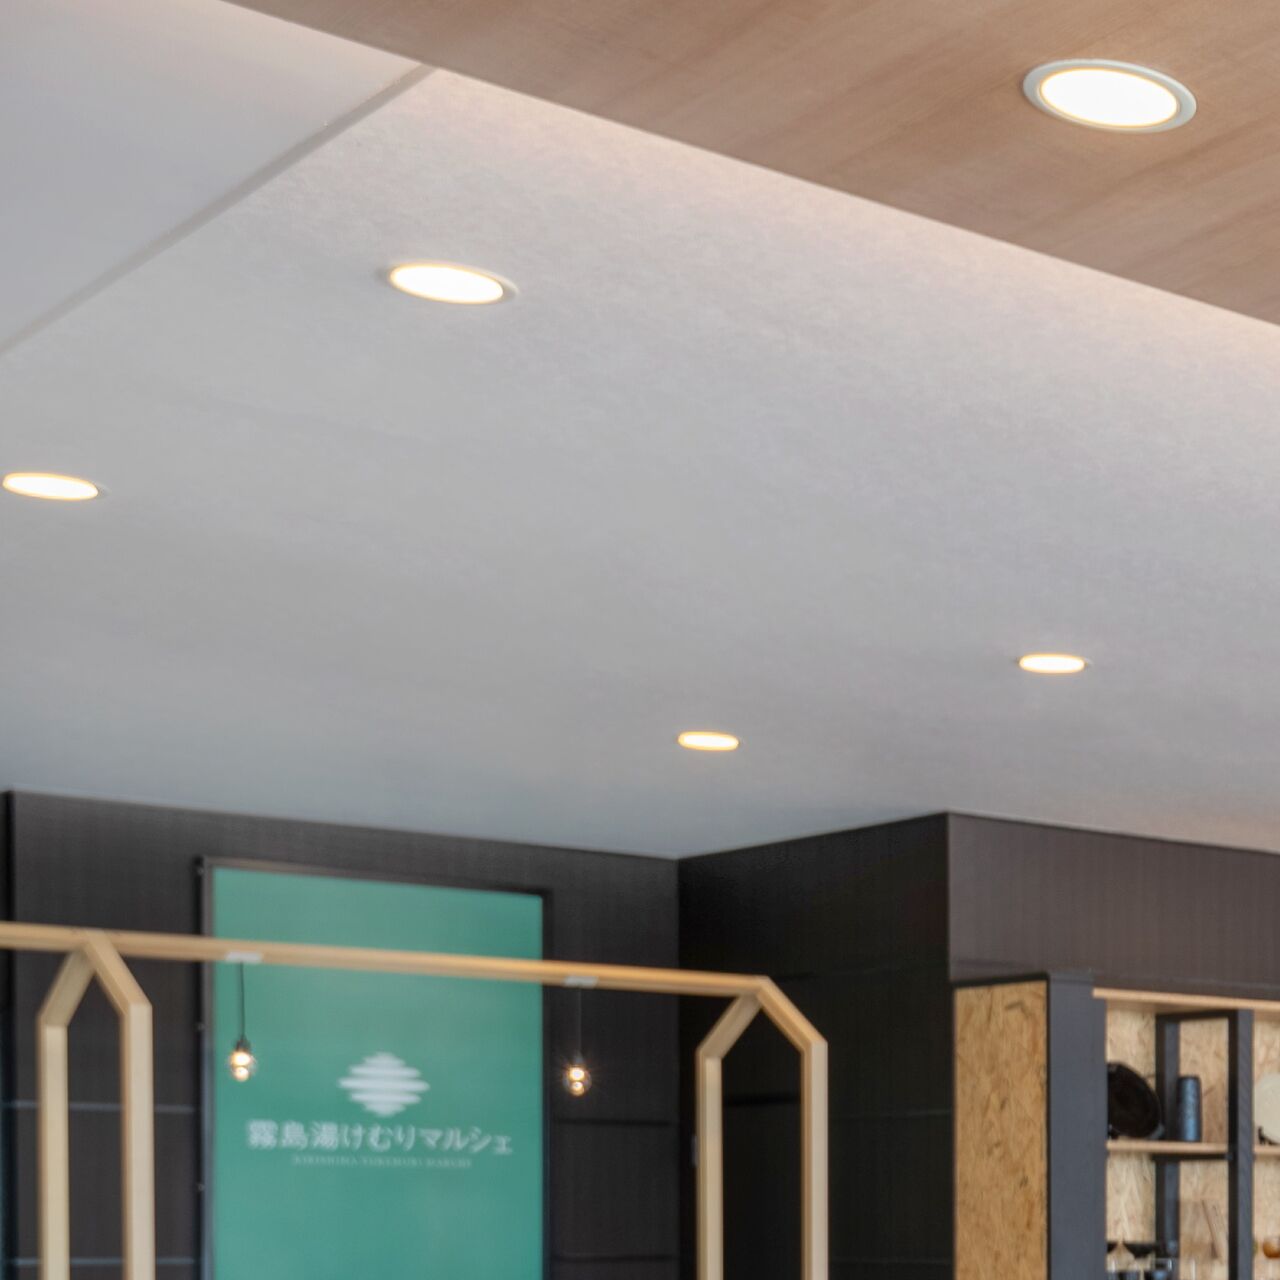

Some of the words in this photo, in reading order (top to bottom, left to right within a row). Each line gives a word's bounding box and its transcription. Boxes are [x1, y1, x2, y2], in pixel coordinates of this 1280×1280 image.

[247, 1119, 513, 1155] 霧島湯けむりマルシェ
